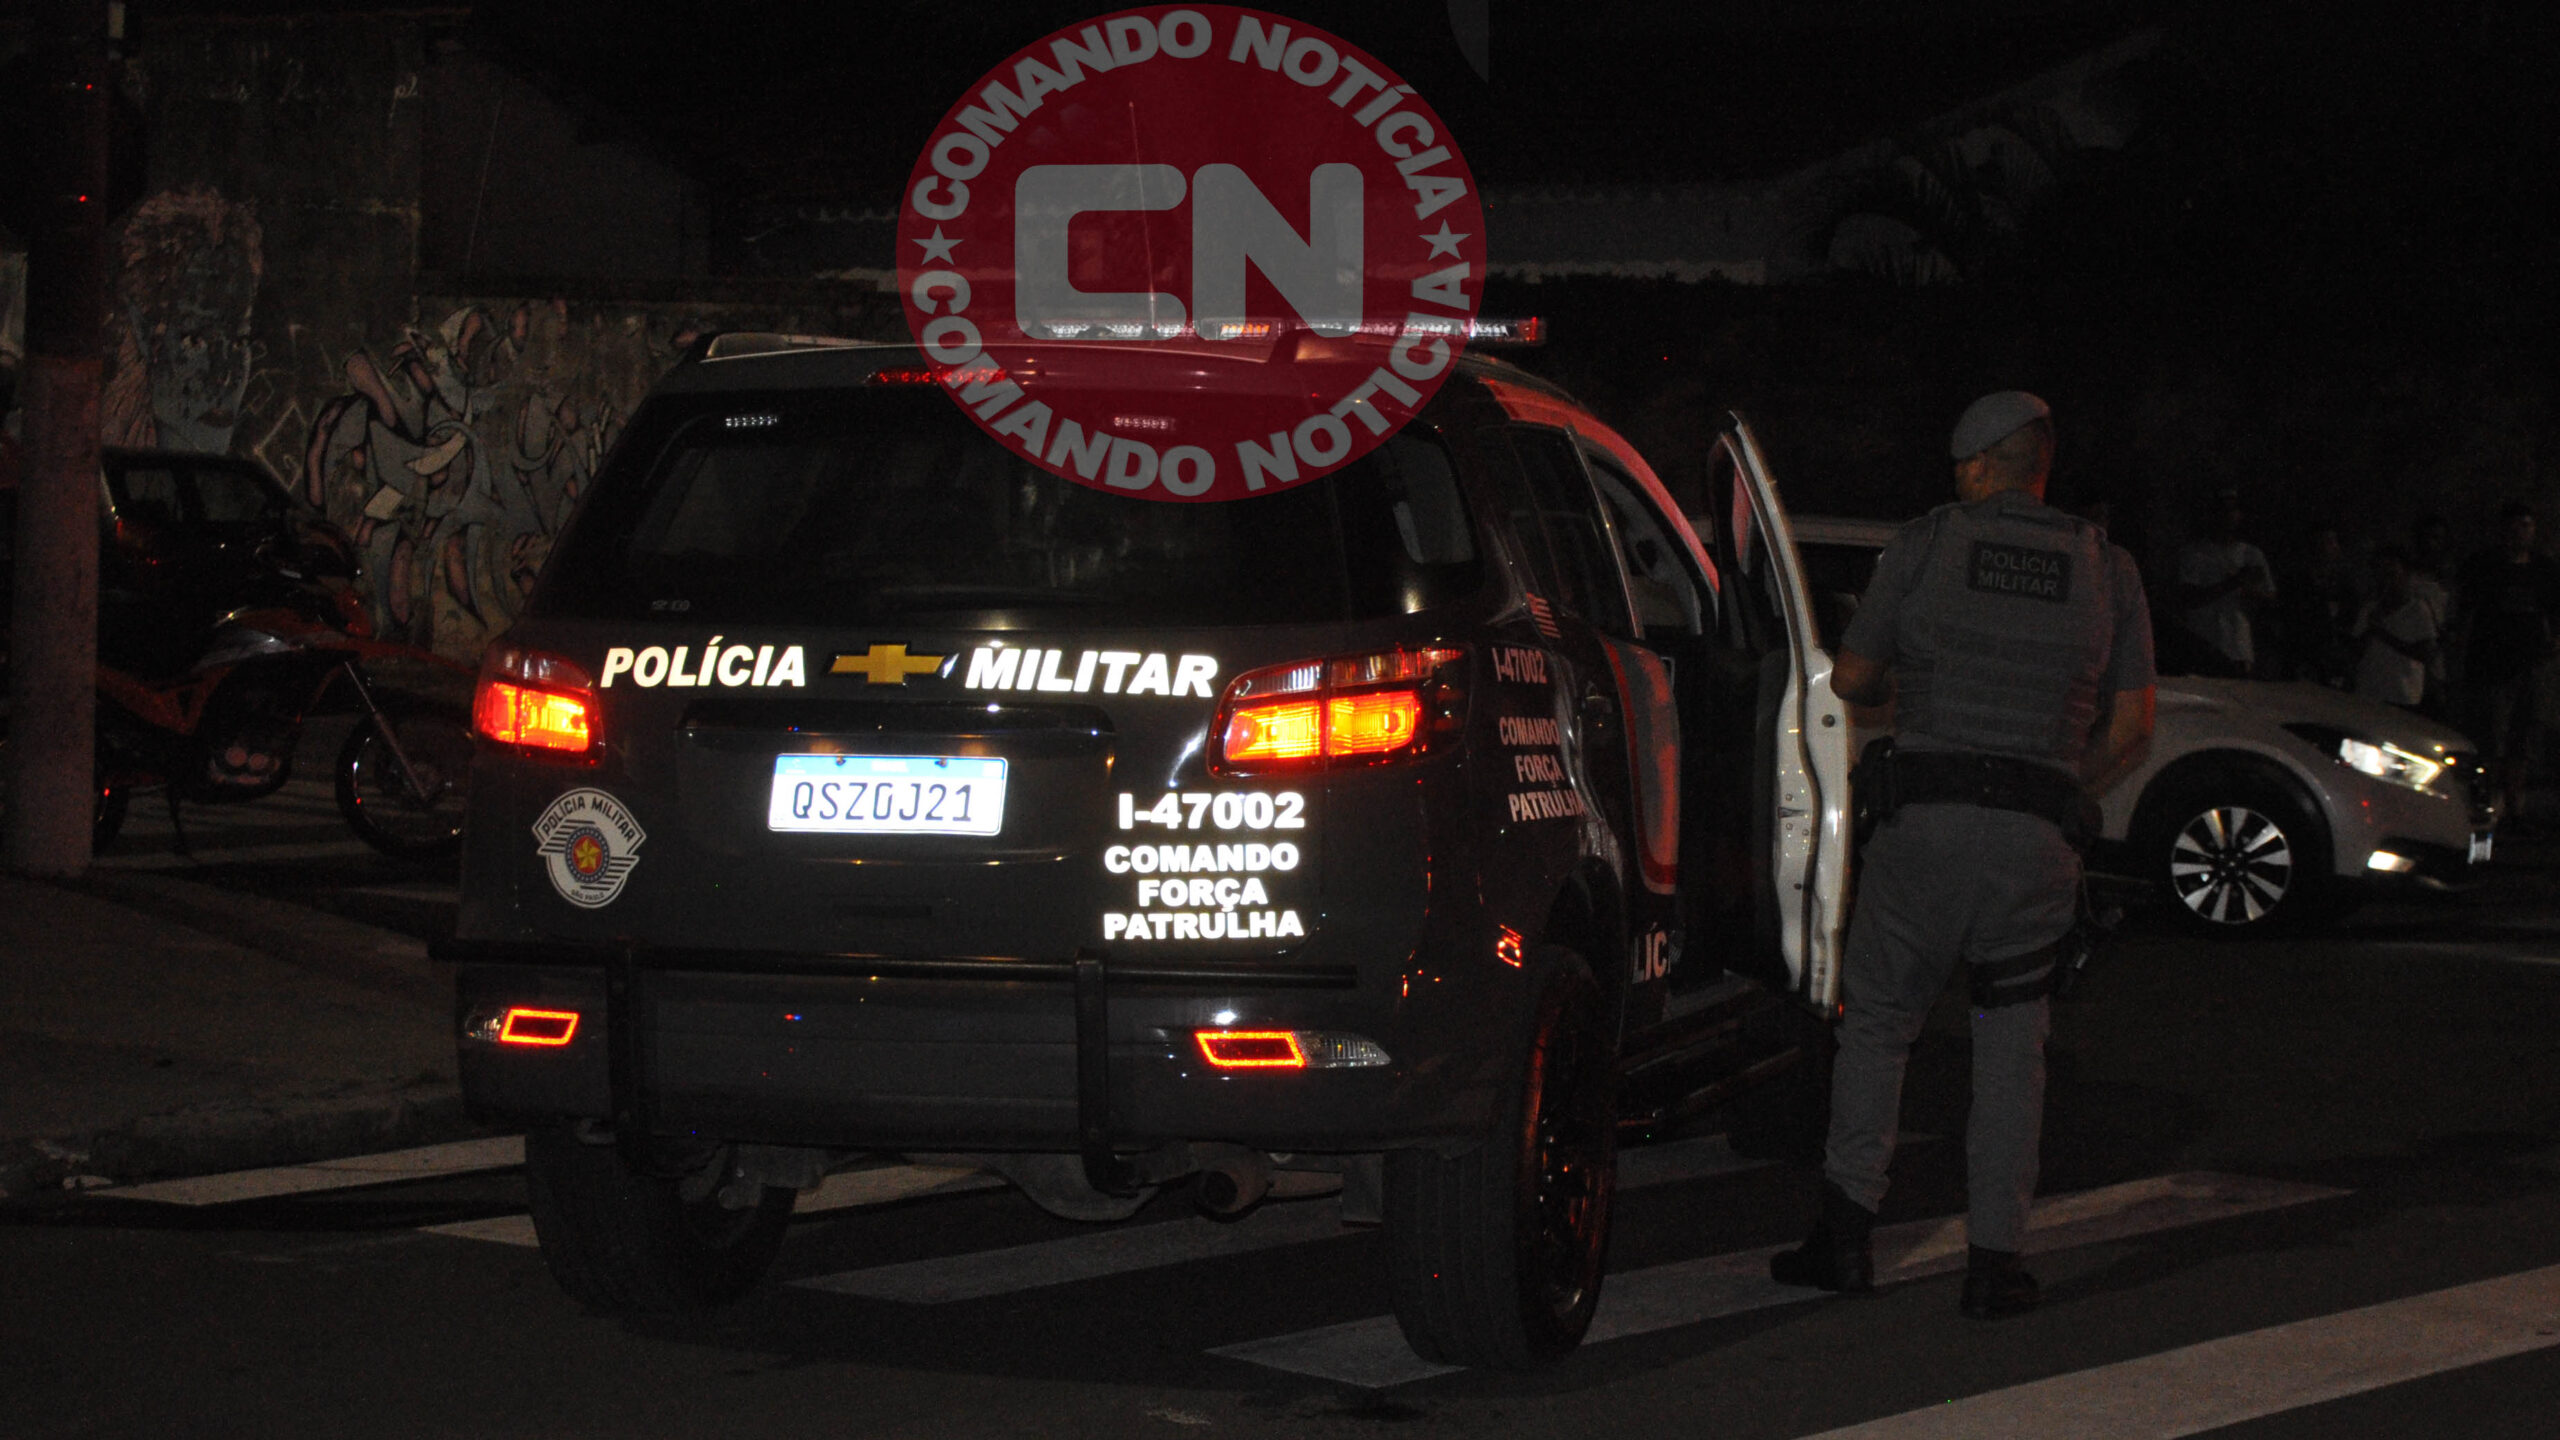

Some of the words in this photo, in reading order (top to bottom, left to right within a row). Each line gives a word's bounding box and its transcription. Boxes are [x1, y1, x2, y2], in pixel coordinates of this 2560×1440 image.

[1978, 570, 2058, 597] MILITAR
[600, 635, 806, 688] POLÍCIA
[965, 647, 1218, 698] MILITAR
[1491, 647, 1548, 685] I-47002
[1499, 716, 1561, 746] COMANDO
[1514, 754, 1566, 789] FORÇA
[592, 797, 636, 842] MILITAR
[1118, 791, 1306, 830] I-47002
[1507, 789, 1588, 823] PATRULHA
[1104, 842, 1300, 874] COMANDO
[1138, 877, 1269, 912] FORÇA
[1104, 910, 1305, 940] PATRULHA
